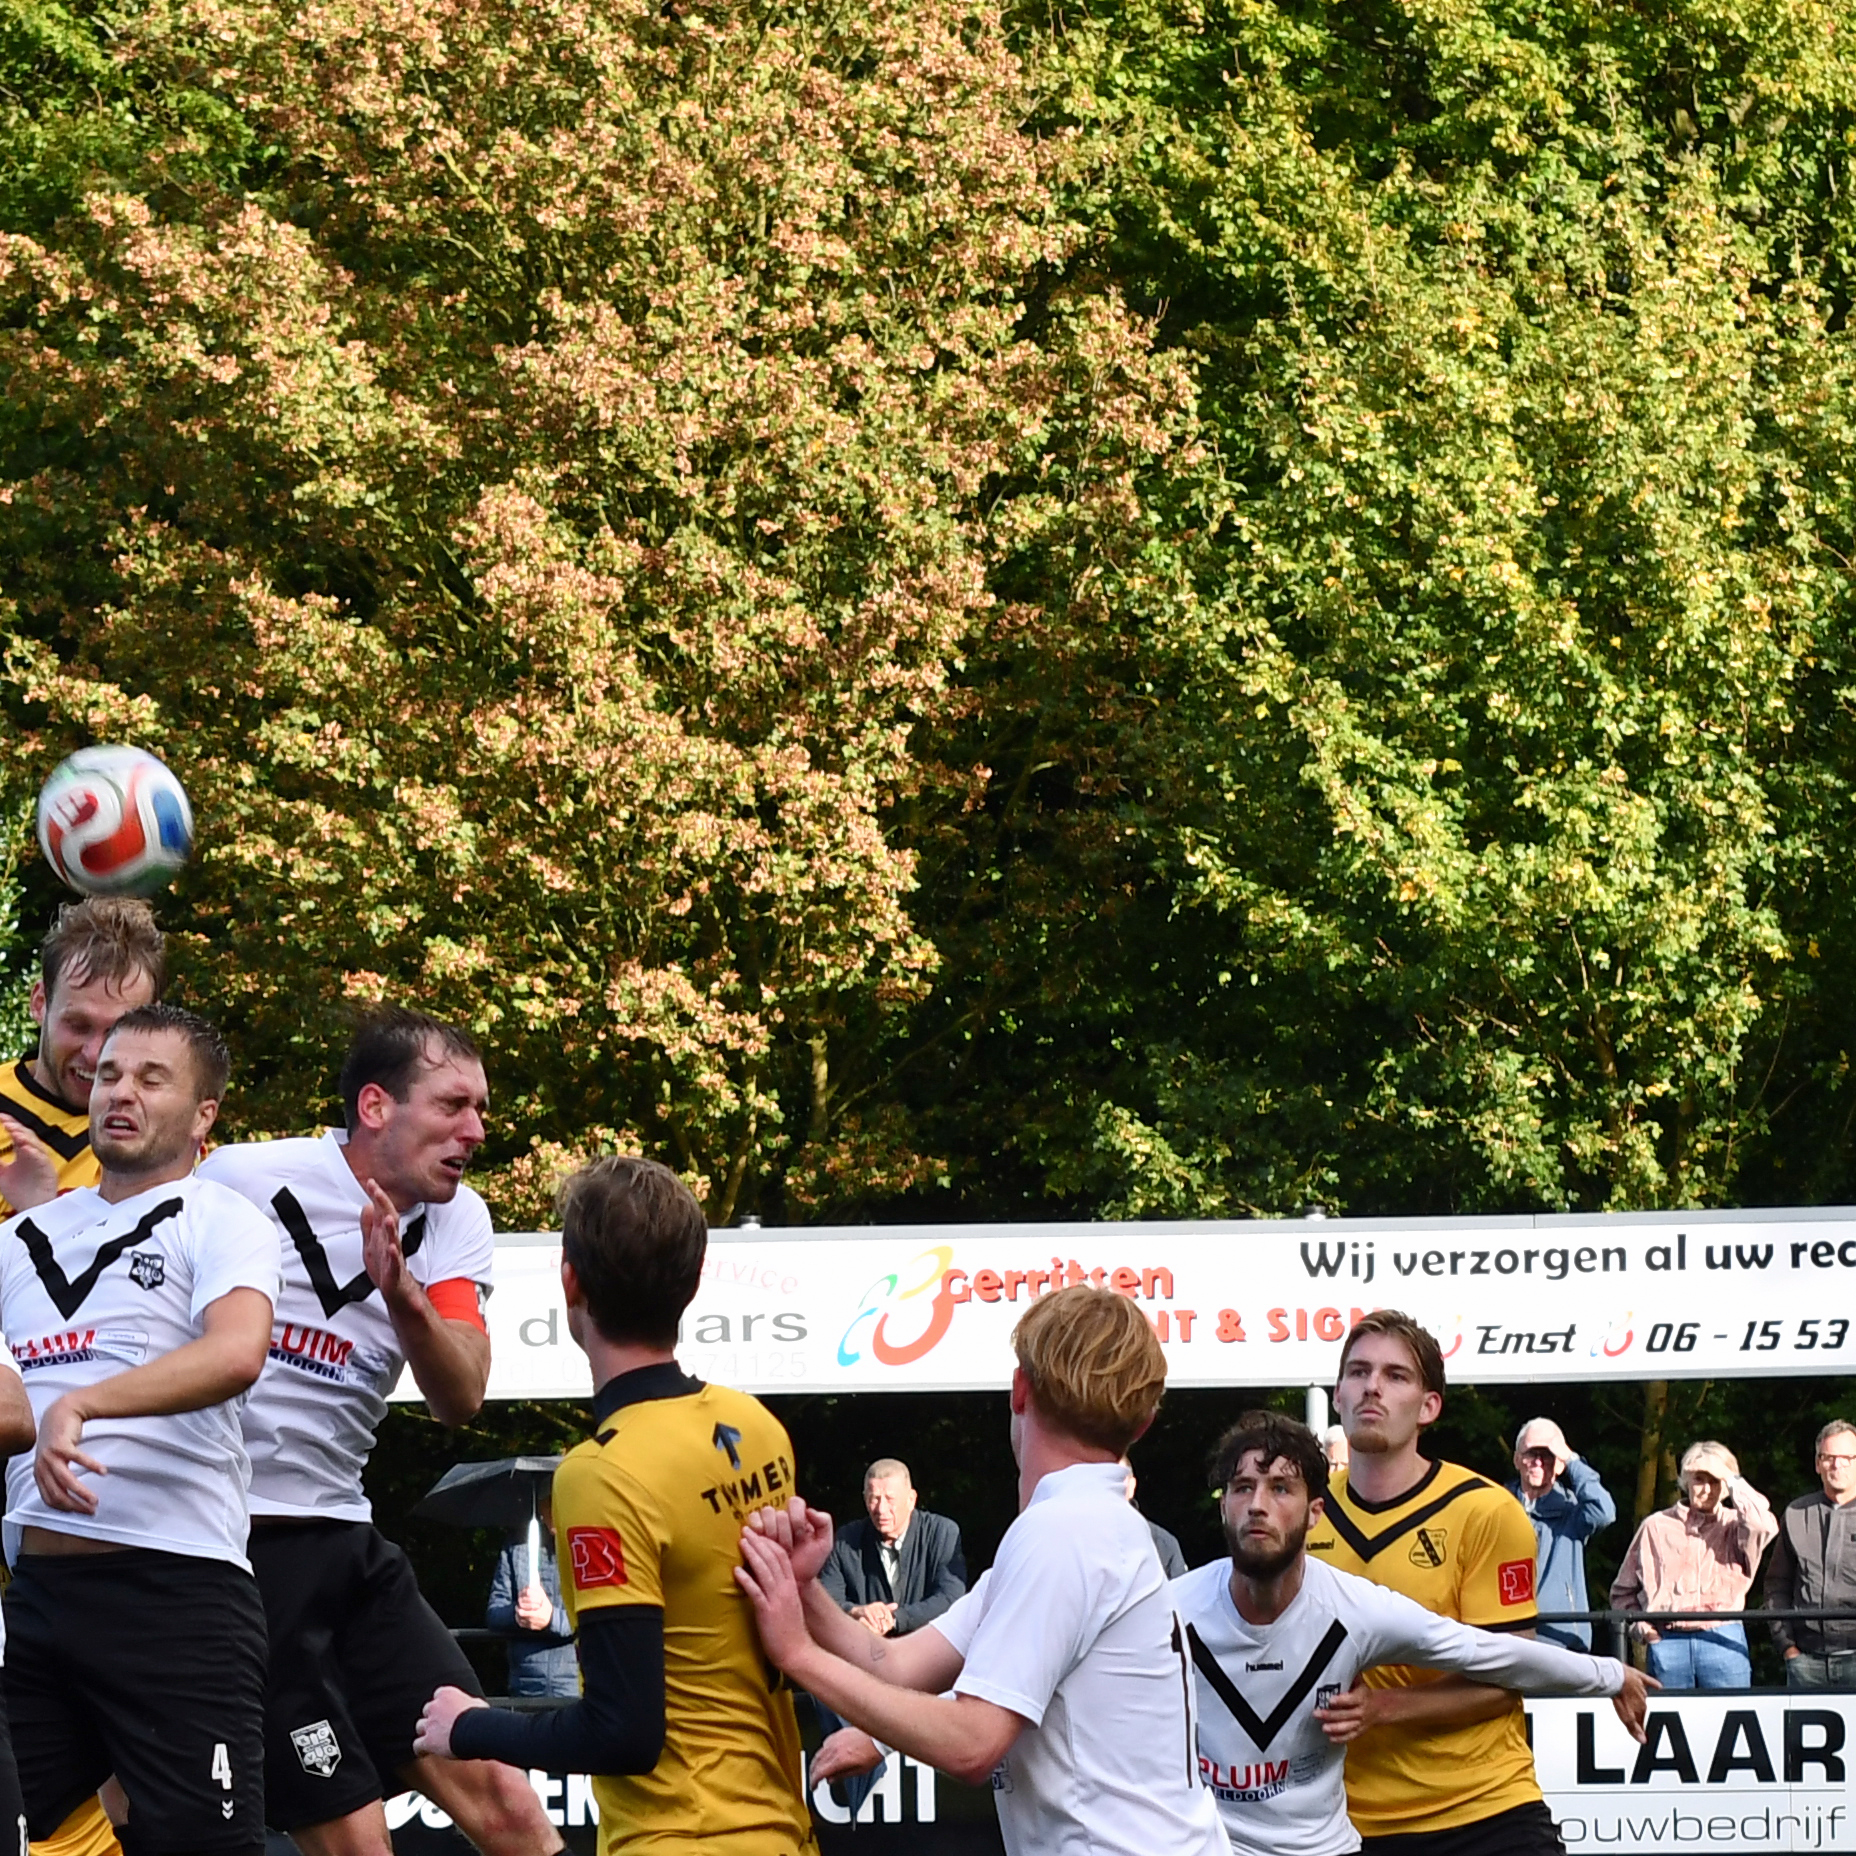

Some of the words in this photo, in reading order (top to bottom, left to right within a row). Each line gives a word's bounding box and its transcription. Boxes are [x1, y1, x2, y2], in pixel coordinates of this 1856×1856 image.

[1299, 1240, 1376, 1285] Wij
[1392, 1244, 1628, 1281] verzorgen
[1644, 1233, 1688, 1272] al
[1704, 1242, 1775, 1271] uw
[1215, 1308, 1247, 1344] &
[1474, 1323, 1578, 1355] Emst
[1645, 1322, 1702, 1354] 06
[1738, 1319, 1785, 1352] 15
[1793, 1318, 1851, 1351] 53
[211, 1743, 233, 1790] 4
[1576, 1709, 1846, 1785] LAAR
[1558, 1805, 1846, 1848] ouwbedrijf
